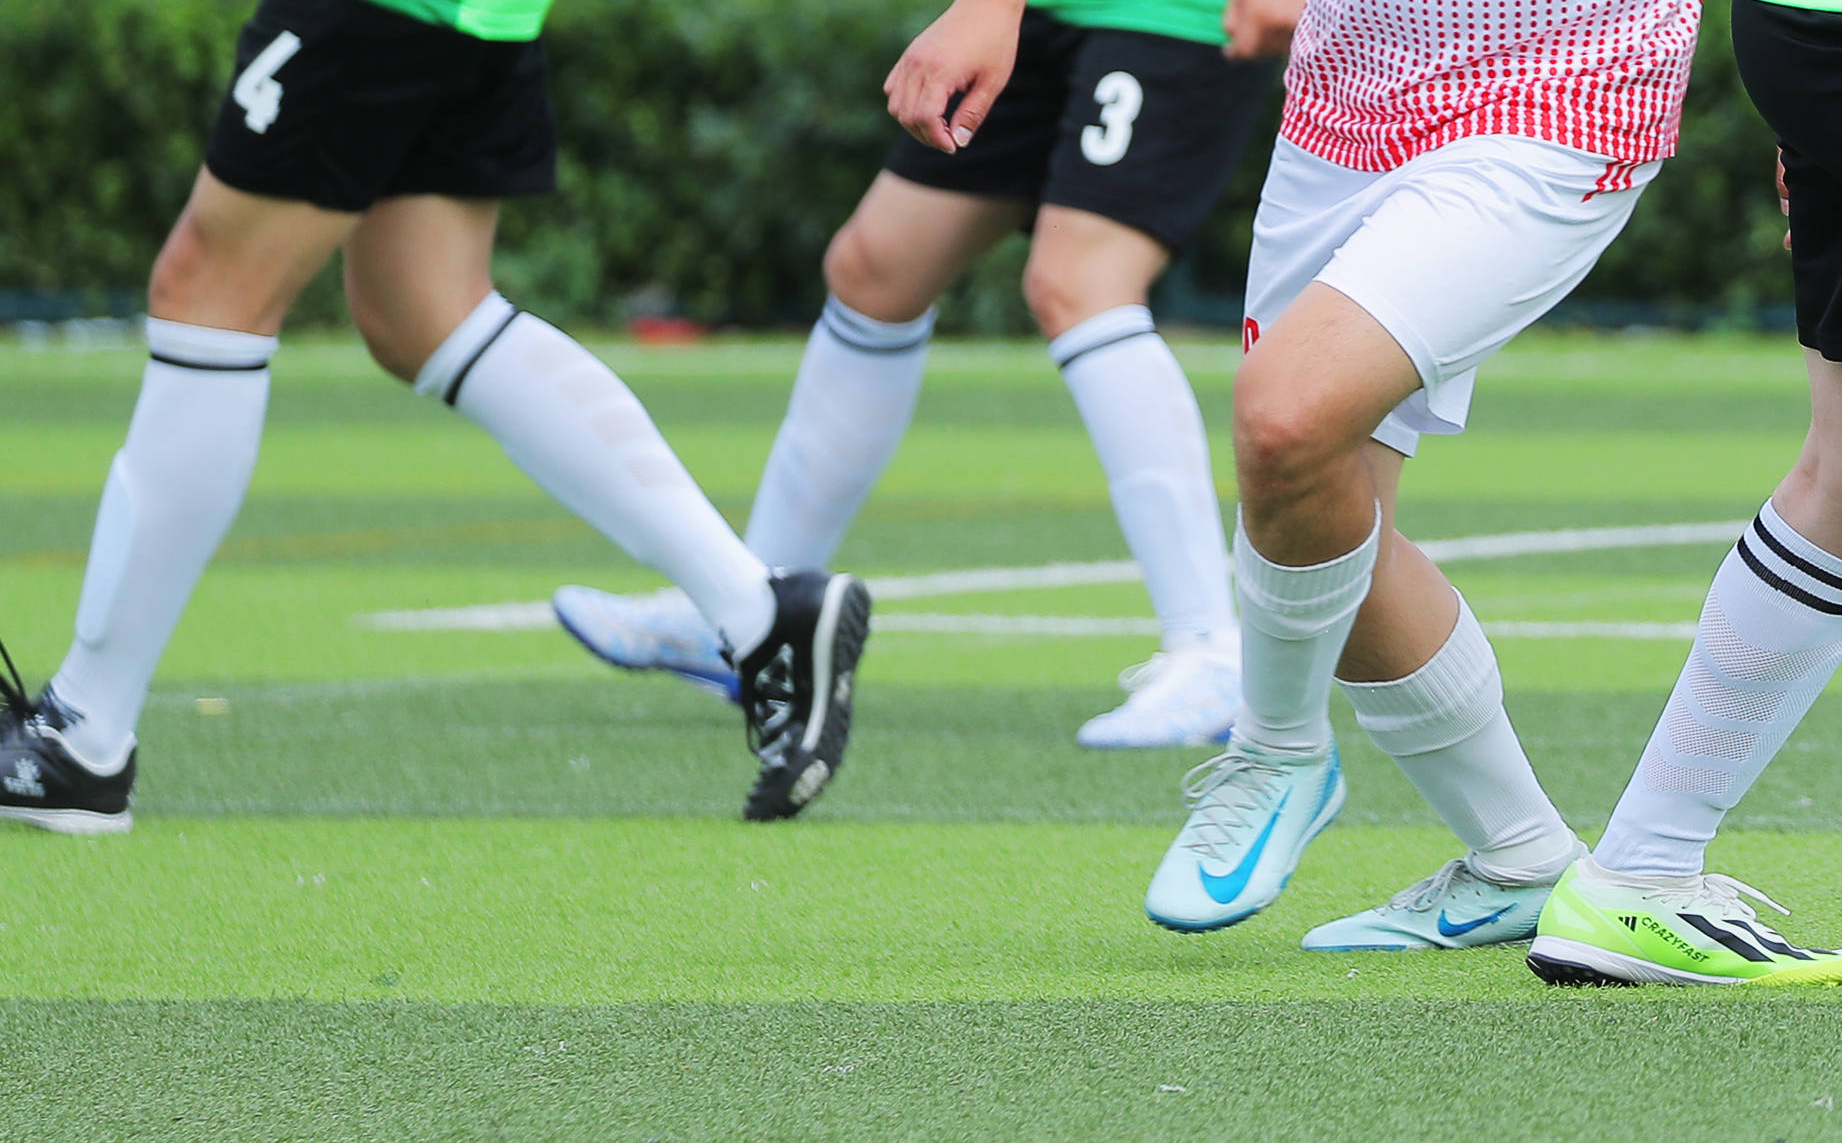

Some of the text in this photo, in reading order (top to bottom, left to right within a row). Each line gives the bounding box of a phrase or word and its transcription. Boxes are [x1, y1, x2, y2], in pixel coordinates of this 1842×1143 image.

[233, 29, 302, 134] 4
[1080, 70, 1143, 166] 3
[1641, 916, 1710, 963] CRAZYFAST
